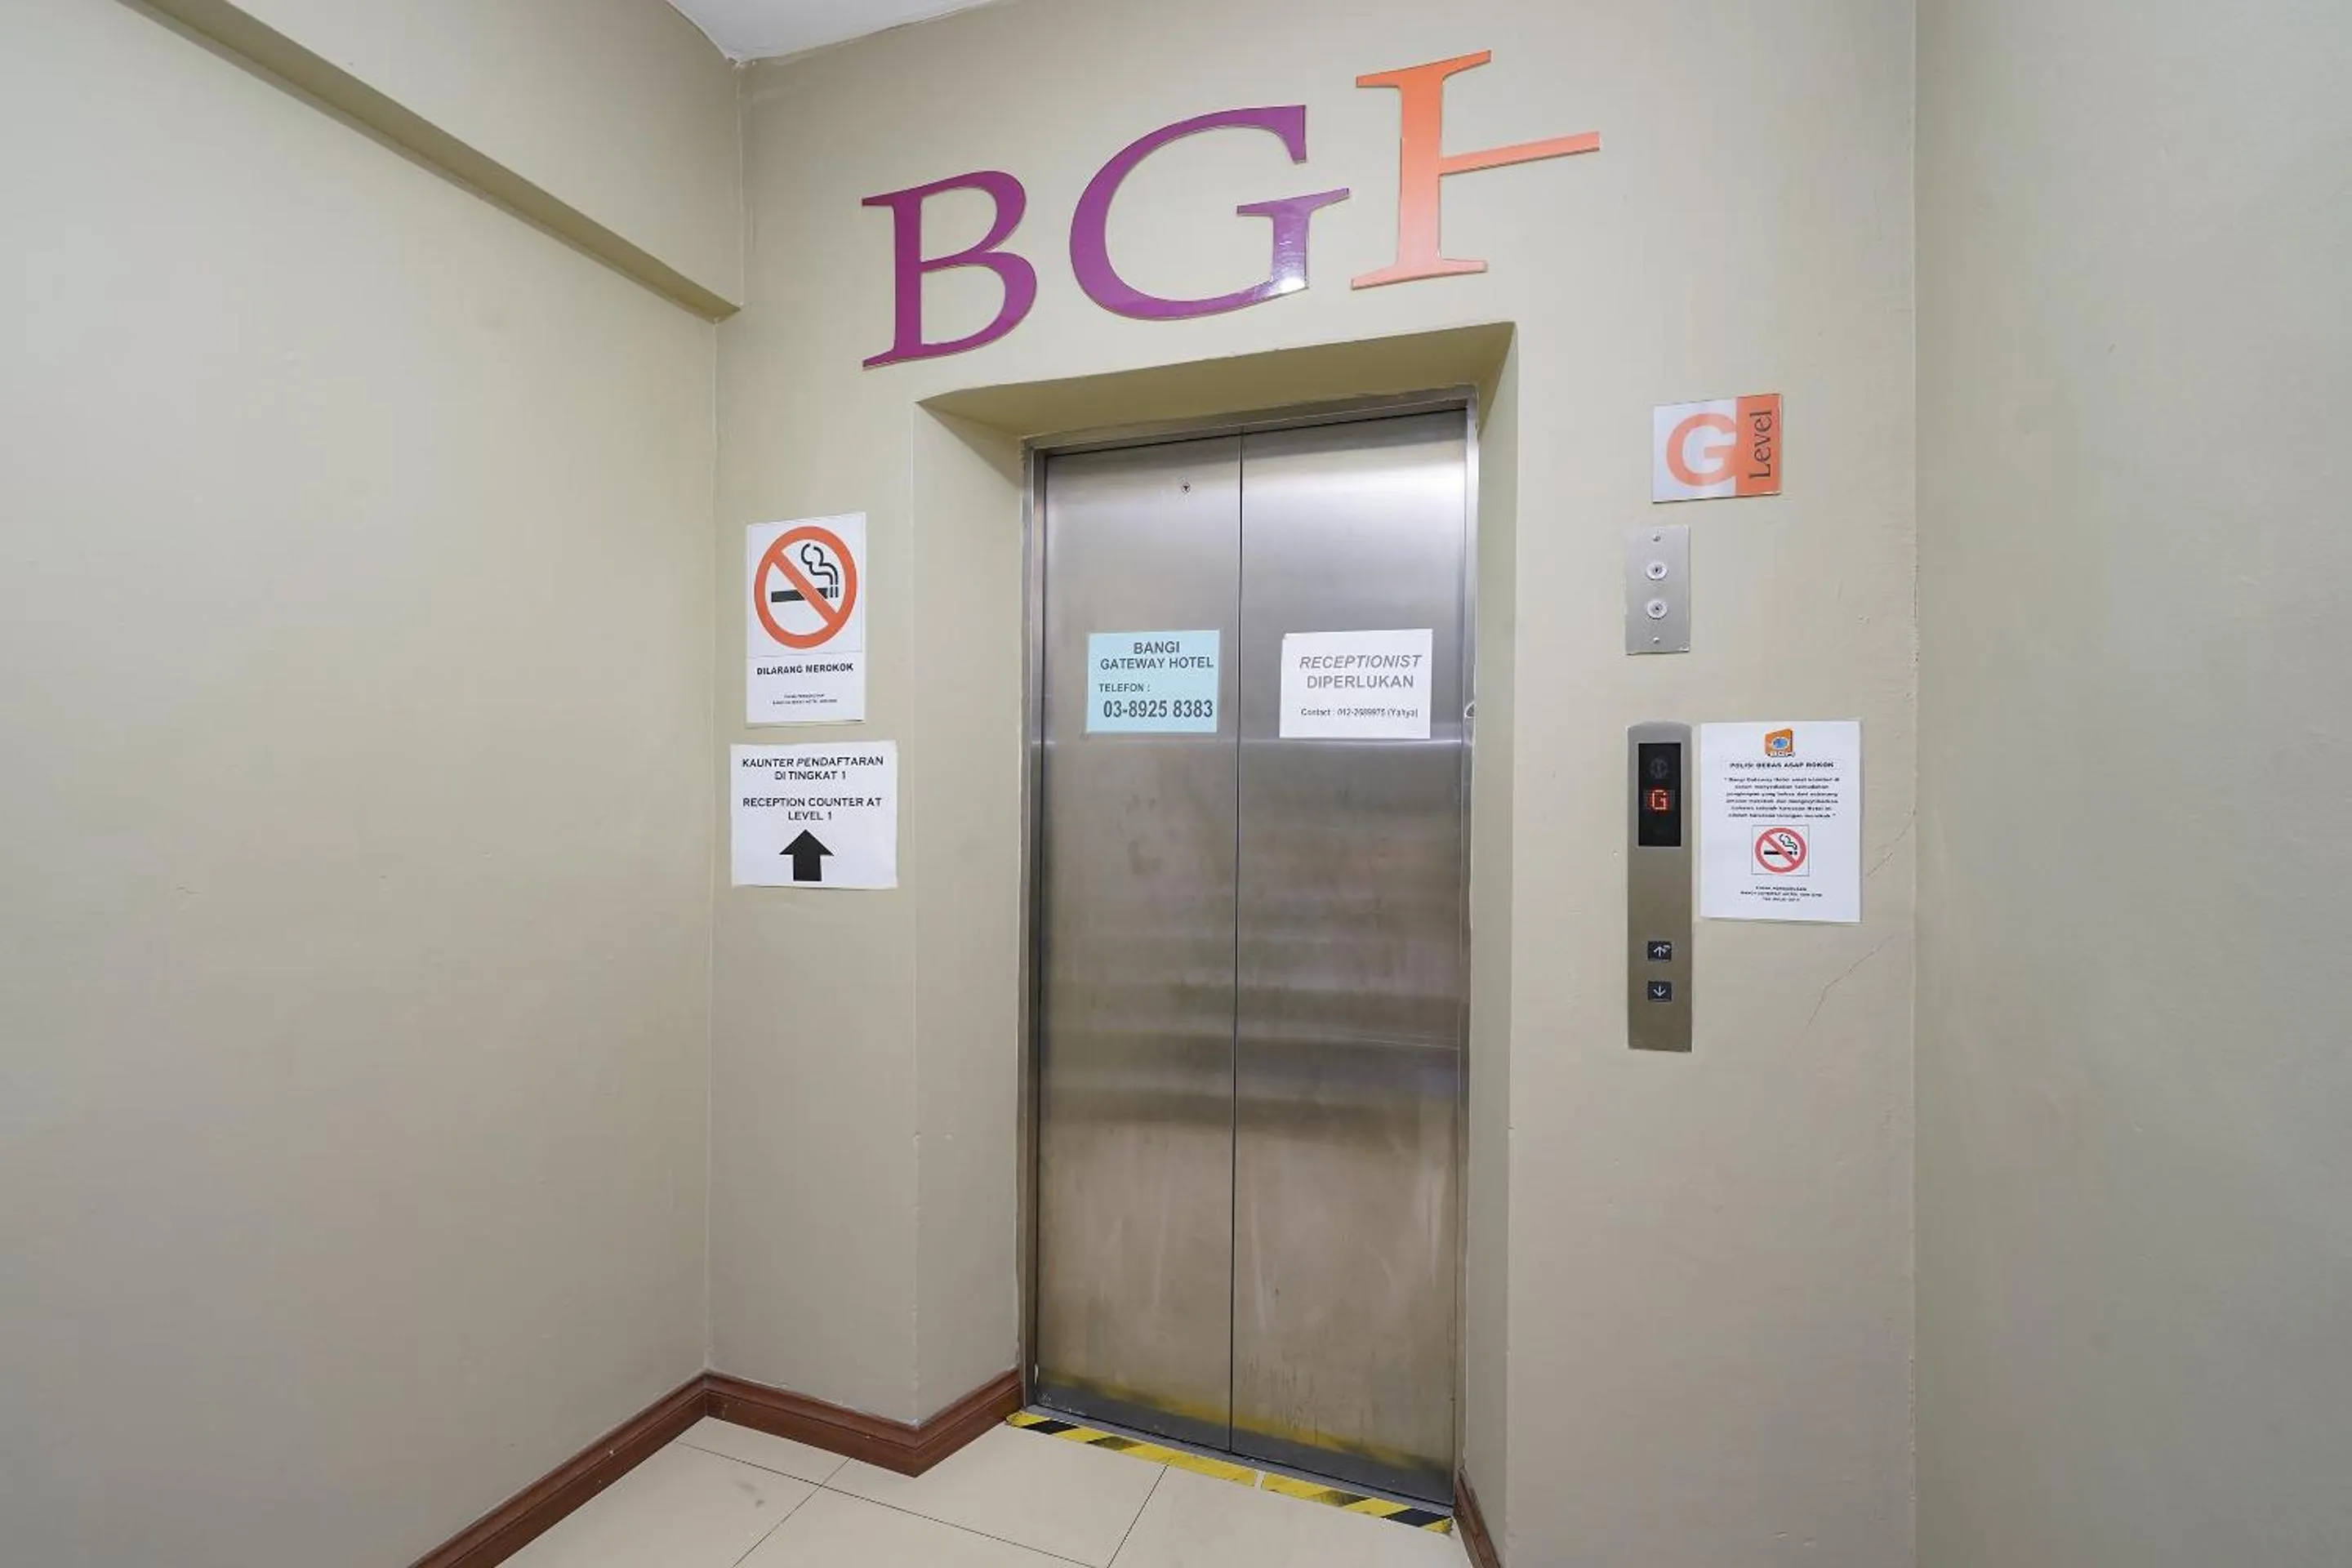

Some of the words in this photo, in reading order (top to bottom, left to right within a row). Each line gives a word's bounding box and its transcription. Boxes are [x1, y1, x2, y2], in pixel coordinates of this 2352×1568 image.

[1666, 412, 1736, 487] G
[1749, 409, 1772, 479] Level
[1133, 640, 1180, 654] BANGI
[1100, 657, 1165, 670] GATEWAY
[1169, 657, 1214, 669] HOTEL
[1299, 654, 1423, 669] RECEPTIONIST
[756, 664, 803, 675] DILARANG
[1099, 683, 1144, 693] TELEFON
[1307, 675, 1414, 688] DIPERLUKAN
[1103, 699, 1168, 718] 03-8925
[1173, 699, 1213, 718] 8383
[1300, 707, 1331, 717] Contact
[742, 758, 795, 768] KAUNTER
[796, 756, 884, 768] PENDAFTARAN
[775, 771, 786, 780] DI
[787, 770, 838, 780] TINGKAT
[841, 771, 846, 780] 1
[742, 797, 805, 807] RECEPTION
[808, 797, 864, 807] COUNTER
[866, 797, 882, 807] AT
[1651, 789, 1667, 810] G
[788, 811, 824, 821] LEVEL
[827, 811, 832, 821] 1
